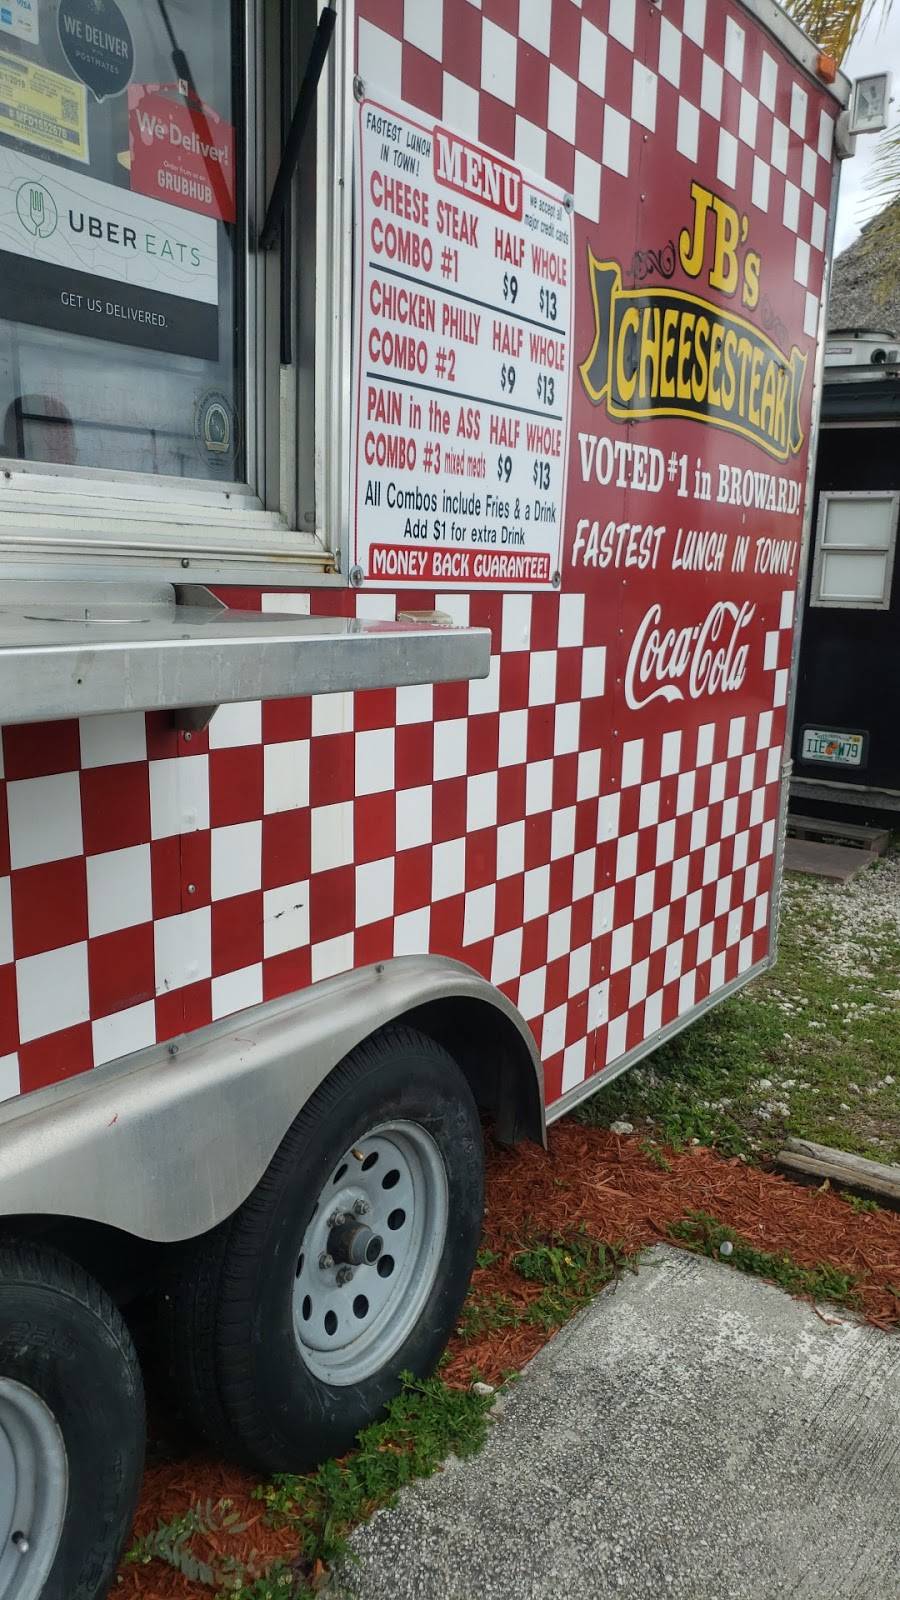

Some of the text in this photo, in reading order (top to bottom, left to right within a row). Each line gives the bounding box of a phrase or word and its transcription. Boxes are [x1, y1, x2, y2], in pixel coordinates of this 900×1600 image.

[64, 14, 82, 39] WE
[85, 24, 129, 59] DELIVER
[136, 109, 229, 165] We Deliver!
[366, 112, 431, 158] FASTEST LUNCH
[380, 143, 420, 177] IN TOWN!
[158, 169, 212, 204] GRUBHUB
[437, 133, 520, 213] MENU
[370, 170, 479, 248] CHEESE STEAK
[524, 213, 568, 245] major credit cards
[539, 199, 555, 217] accept
[69, 210, 201, 267] UBER EATS
[370, 217, 459, 282] COMBO #1
[494, 227, 567, 287] HALF WHOLE
[678, 180, 761, 309] JB's
[61, 292, 168, 328] GET US DELIVERED.
[370, 279, 481, 346] CHICKEN PHILLY
[503, 272, 557, 321] $9 $13
[368, 327, 456, 382] COMBO #2
[493, 320, 565, 372] HALF WHOLE
[500, 363, 555, 406] $9 $13
[616, 306, 789, 447] CHEESESTEAK
[367, 386, 481, 441] PAIN in the ASS
[489, 414, 562, 457] HALF WHOLE
[365, 431, 486, 480] COMBO #3 mixed meats
[497, 453, 551, 491] $9 $13
[578, 432, 801, 516] VOTED #1 in BROWARD!
[364, 480, 556, 523] All Combos include Fries & a Drink
[404, 517, 525, 545] Add $1 for extra Drink
[571, 518, 797, 577] FASTEST LUNCH IN TOWN!
[372, 548, 549, 579] MONEY BACK GUARANTEE!
[624, 601, 756, 710] Coca-Cola
